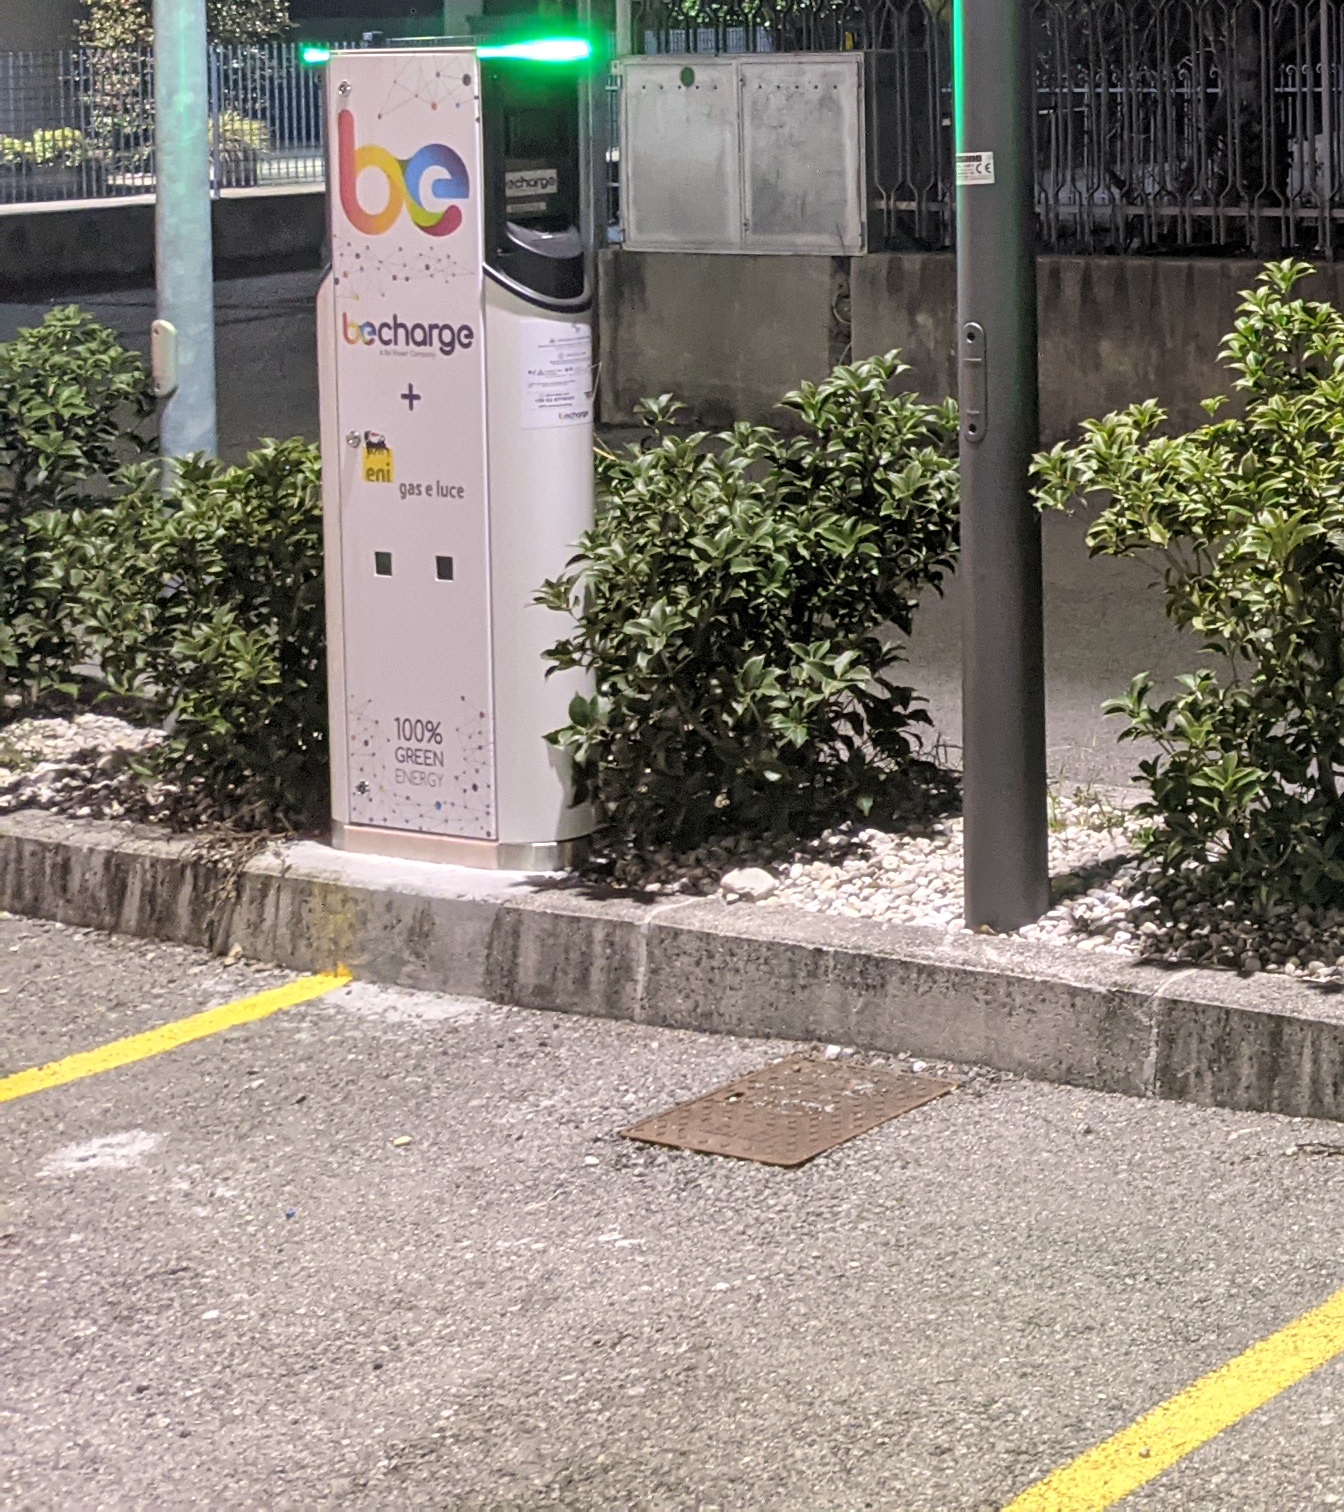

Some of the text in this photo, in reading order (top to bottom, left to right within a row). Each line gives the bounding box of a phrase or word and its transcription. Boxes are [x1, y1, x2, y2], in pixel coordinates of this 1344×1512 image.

[337, 109, 470, 237] be
[507, 175, 556, 190] echarge
[343, 312, 474, 355] becharge
[365, 462, 392, 482] eni
[400, 480, 465, 499] gas e luce
[394, 717, 443, 745] 100%
[394, 746, 444, 767] GREEN
[395, 768, 444, 788] ENERGY
